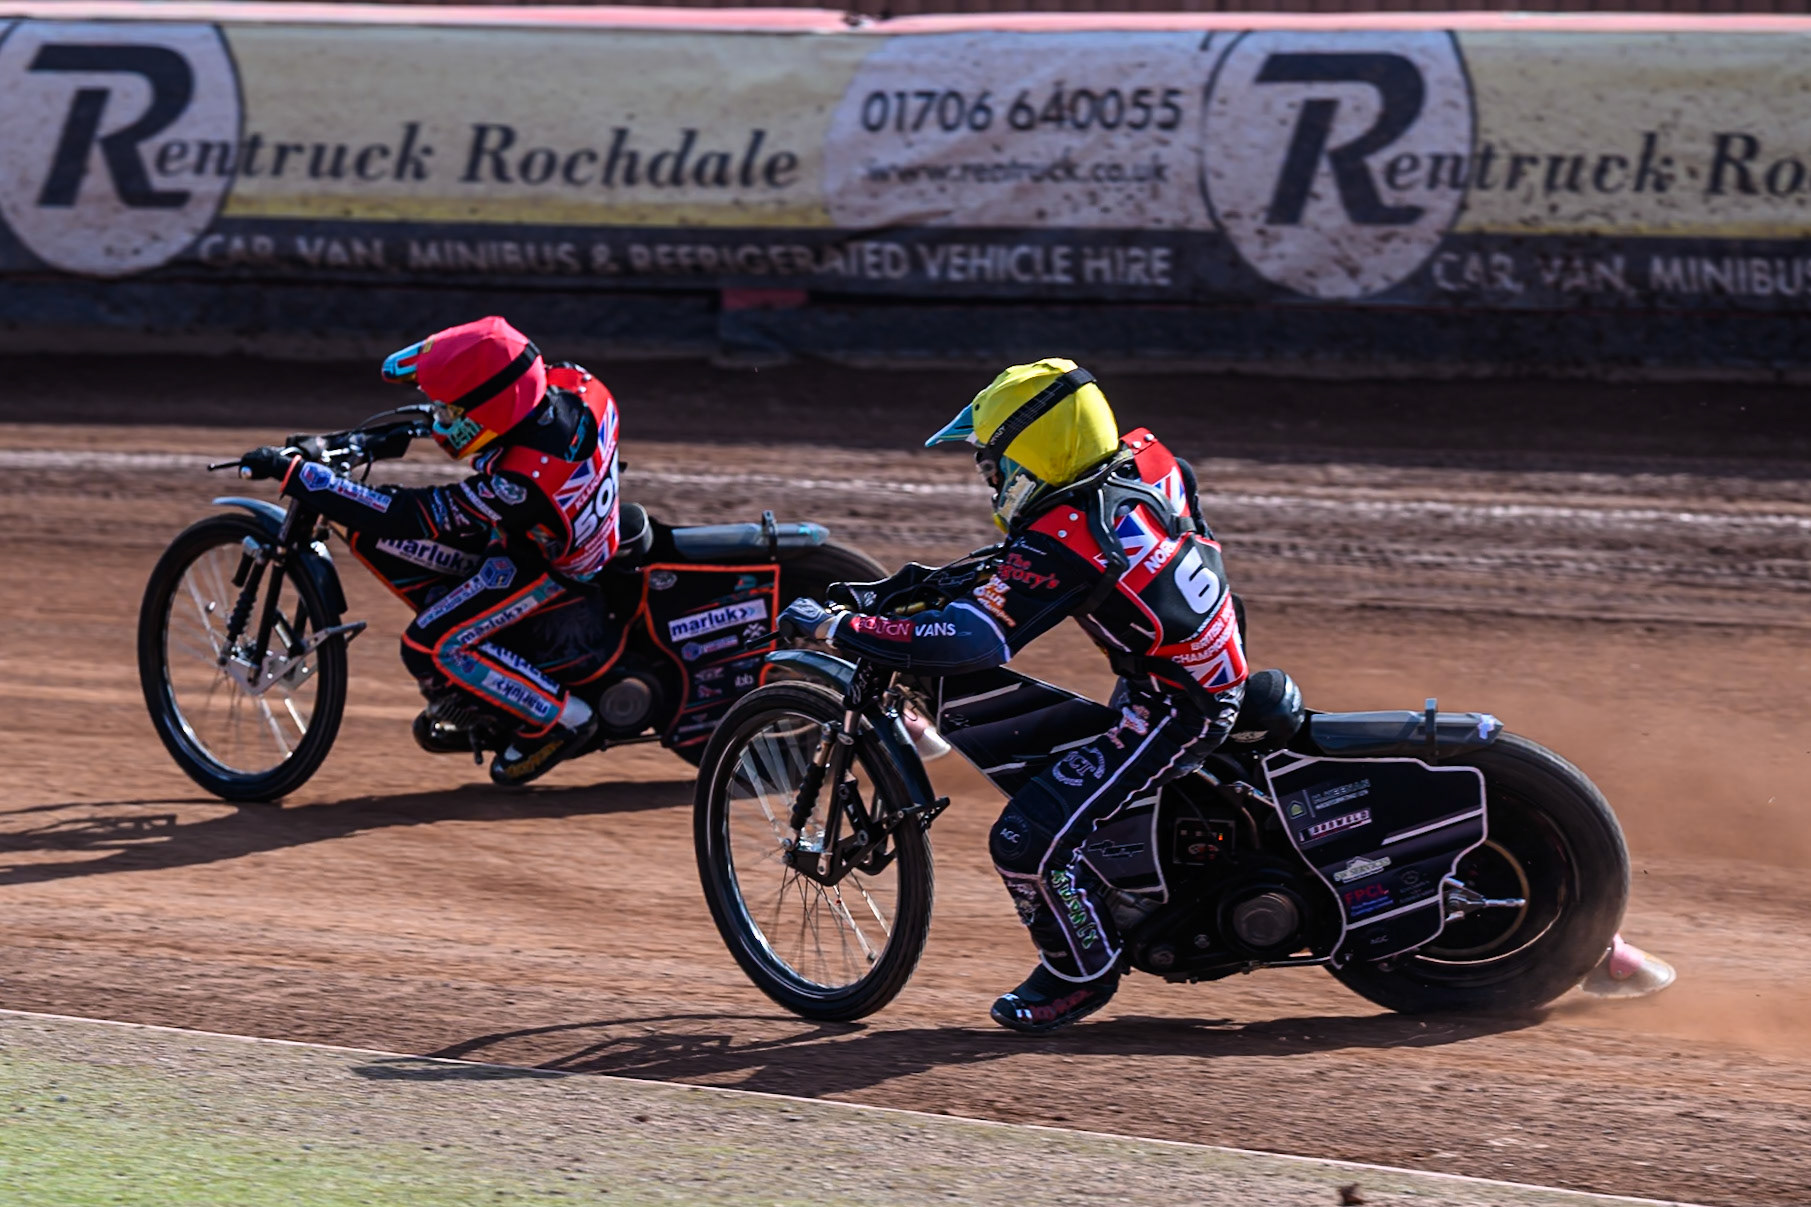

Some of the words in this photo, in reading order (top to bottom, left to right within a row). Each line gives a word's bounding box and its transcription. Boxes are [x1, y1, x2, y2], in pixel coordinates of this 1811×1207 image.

[27, 43, 434, 209] Rentruck
[459, 122, 799, 189] Rochdale
[861, 89, 994, 132] 01706
[1006, 86, 1183, 132] 640055
[1254, 52, 1675, 226] Rentruck
[1703, 131, 1811, 198] Ro
[916, 244, 1073, 283] VEHICLE
[1082, 246, 1173, 286] HIRE
[1650, 255, 1811, 297] MINIBU
[1173, 545, 1221, 615] 6
[671, 608, 737, 637] marluk
[914, 621, 957, 638] VANS
